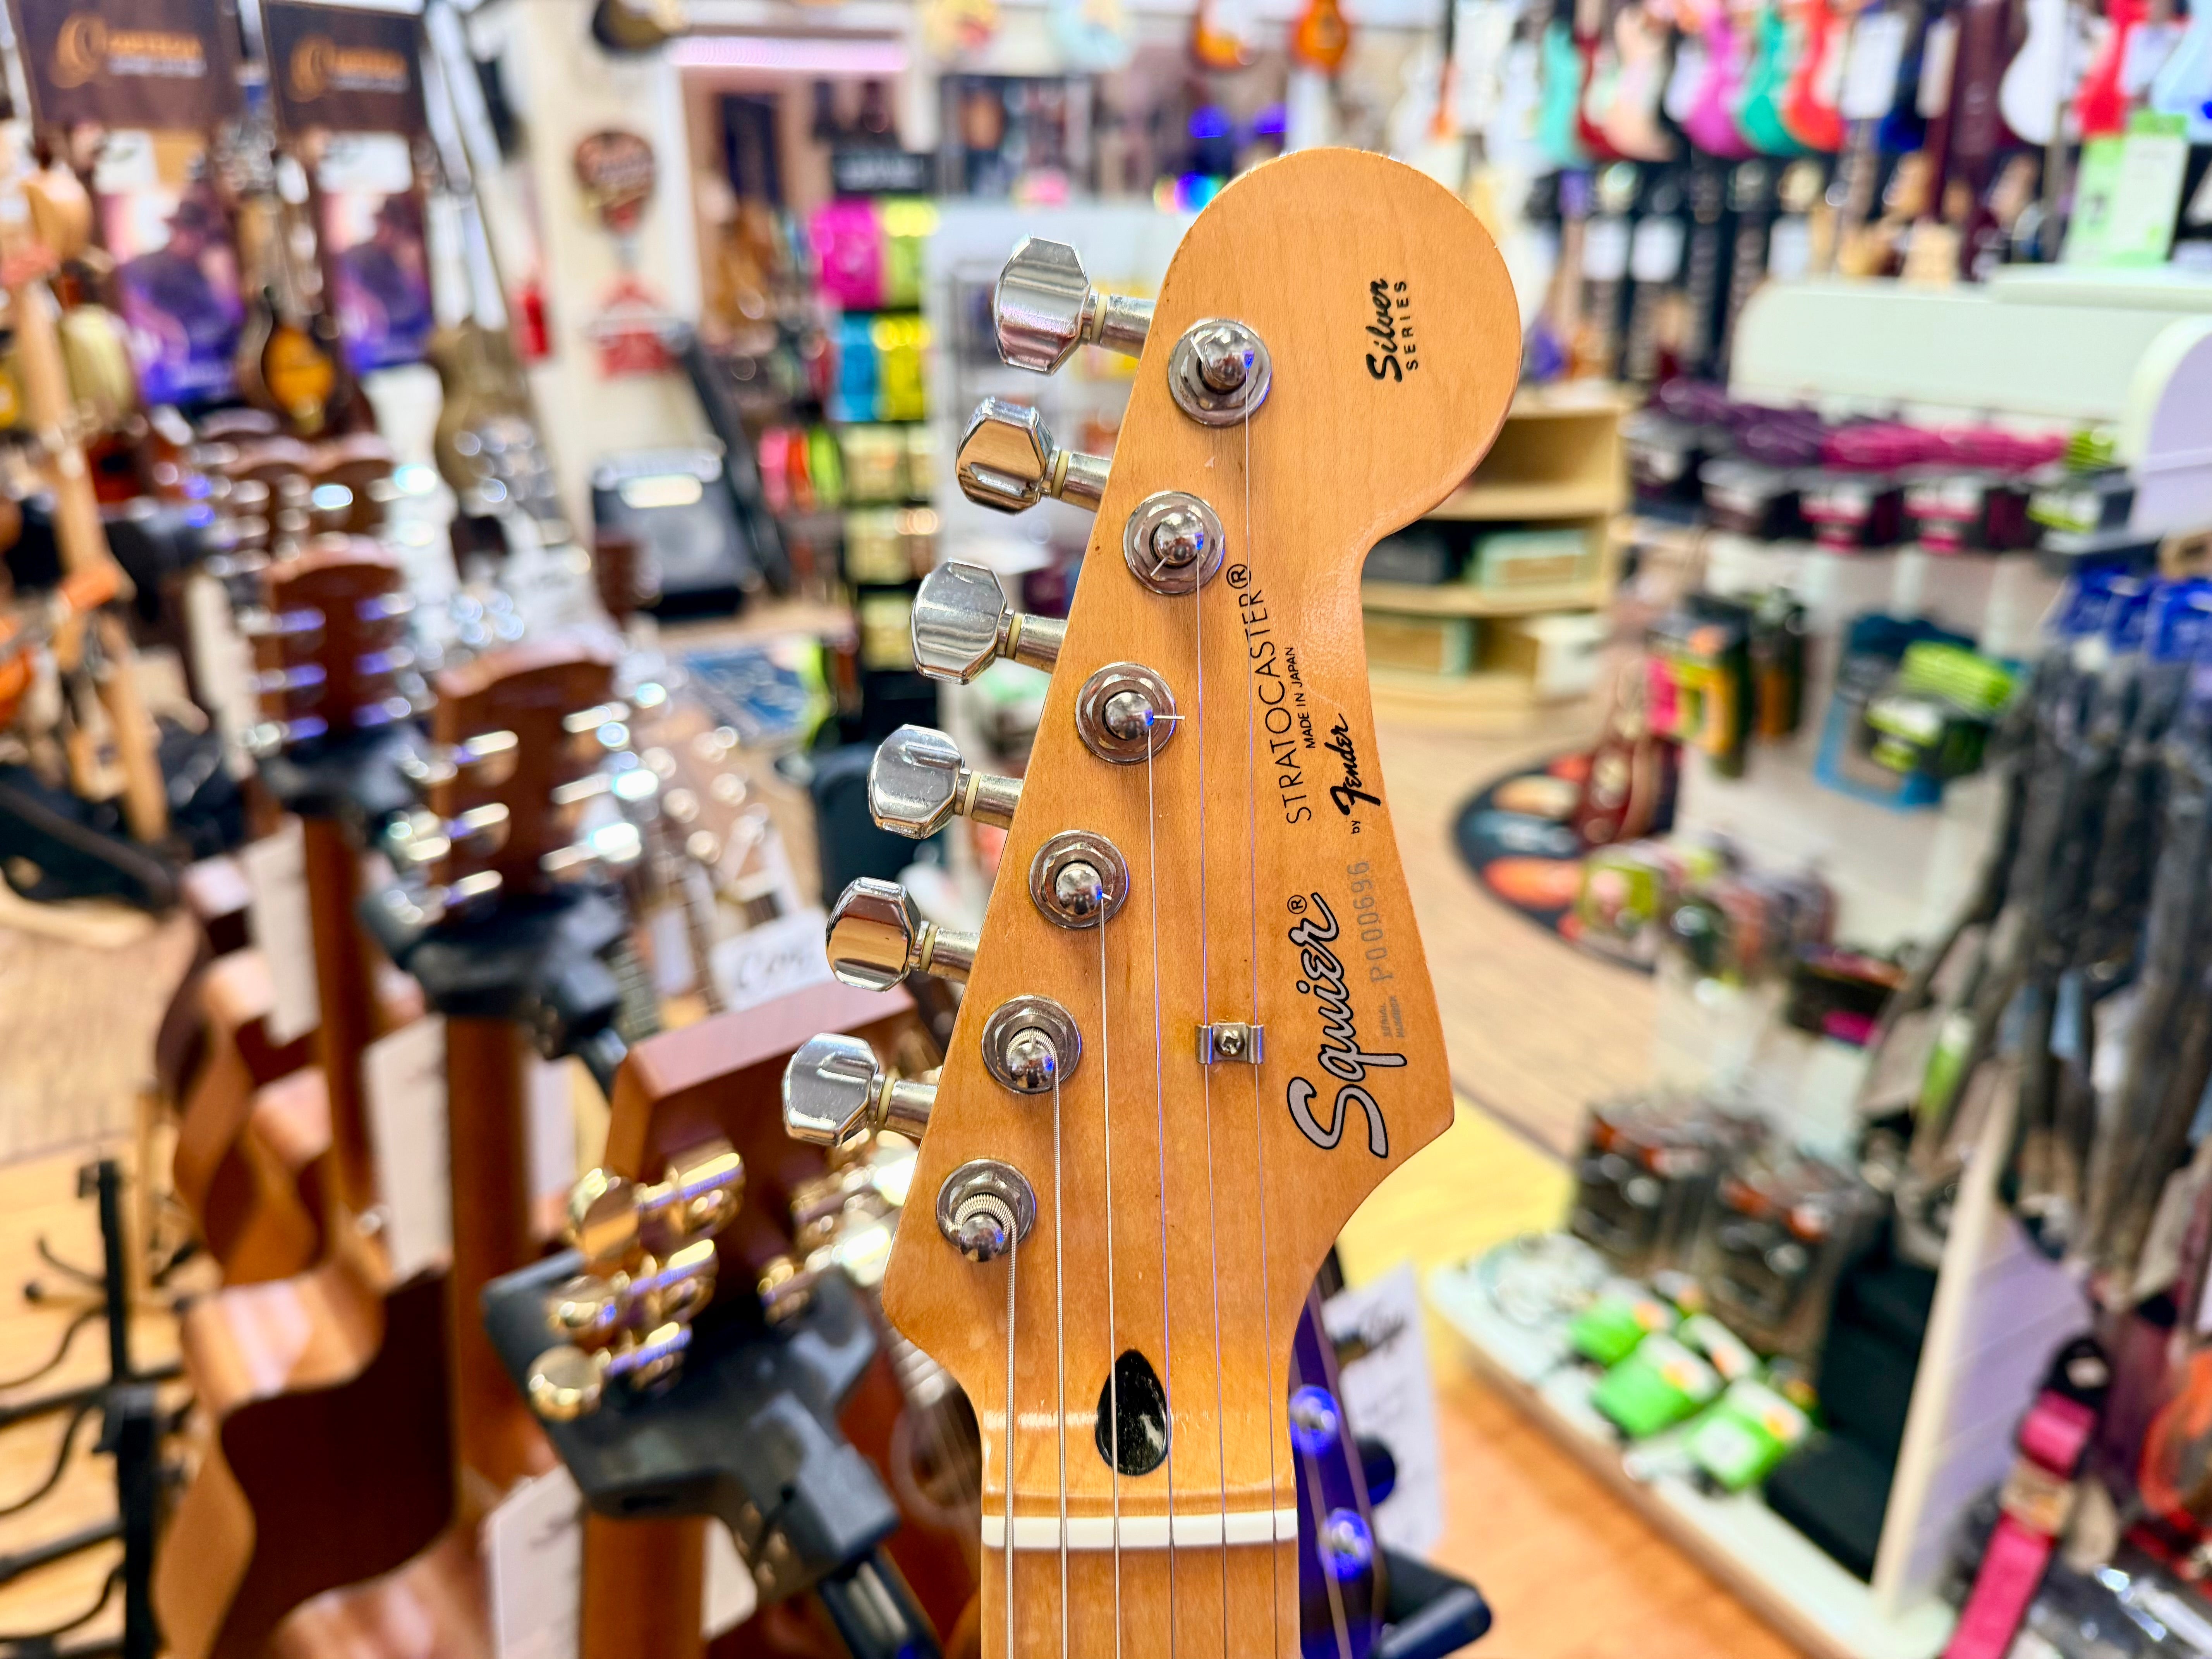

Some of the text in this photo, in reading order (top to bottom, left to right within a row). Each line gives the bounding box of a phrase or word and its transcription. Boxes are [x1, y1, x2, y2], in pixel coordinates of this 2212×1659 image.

[1365, 277, 1403, 383] Silver
[1394, 281, 1419, 371] SERIES
[1285, 647, 1316, 749] MADE IN JAPAN
[1323, 713, 1381, 835] by Fender
[1346, 861, 1394, 982] P000696
